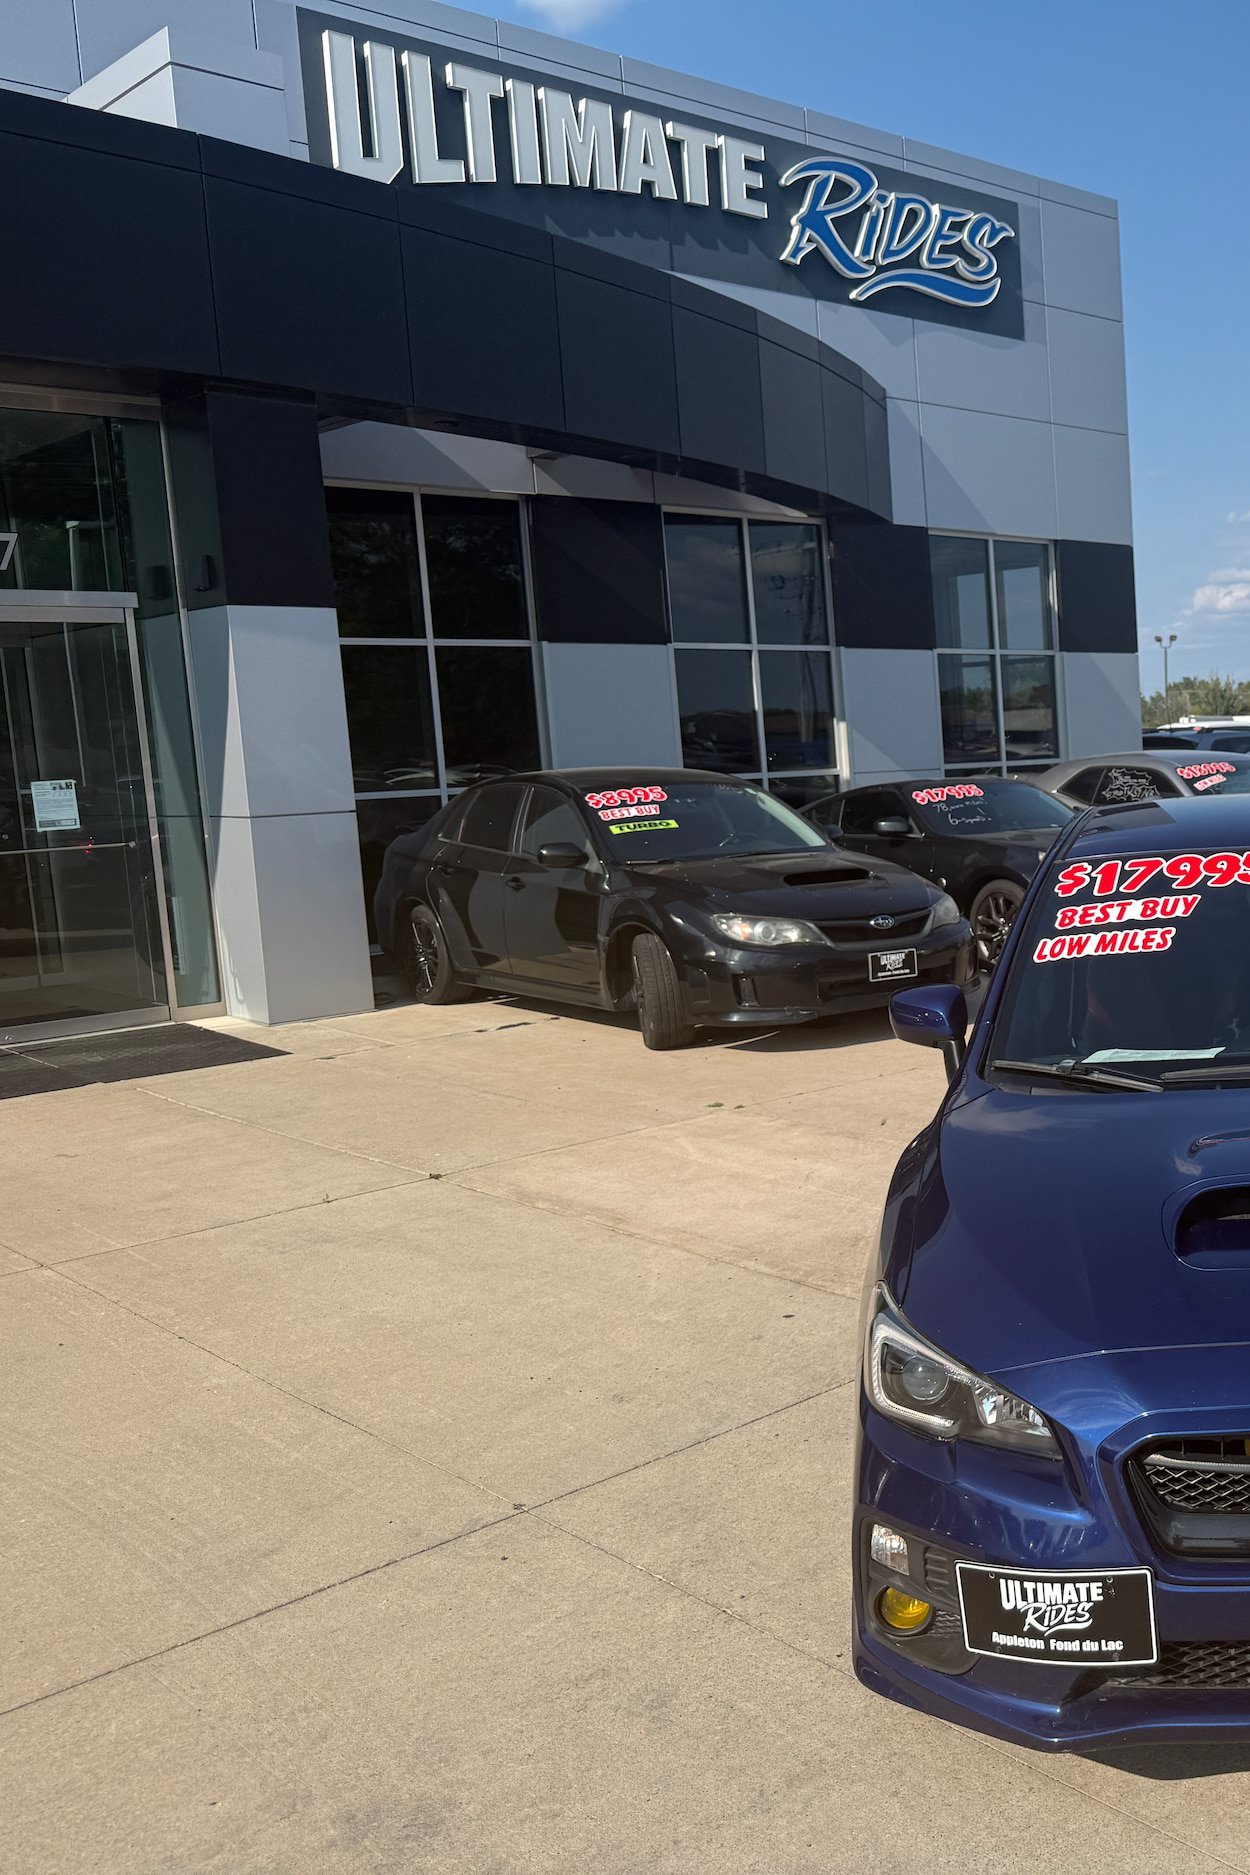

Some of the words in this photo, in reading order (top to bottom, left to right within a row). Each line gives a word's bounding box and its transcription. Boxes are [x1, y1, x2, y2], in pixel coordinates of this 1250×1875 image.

[322, 29, 768, 219] ULTIMATE
[585, 786, 668, 808] $8995
[599, 807, 632, 820] BEST
[634, 804, 661, 817] BUY
[616, 821, 670, 832] TURBO
[1056, 900, 1134, 930] BEST
[1139, 895, 1201, 921] BUY
[1034, 935, 1092, 963] LOW
[1093, 927, 1175, 955] MILES
[999, 1578, 1104, 1611] ULTIMATE
[991, 1631, 1045, 1650] Appleton
[1050, 1639, 1080, 1652] Fond
[1082, 1638, 1100, 1651] du
[1101, 1639, 1124, 1651] Lac
